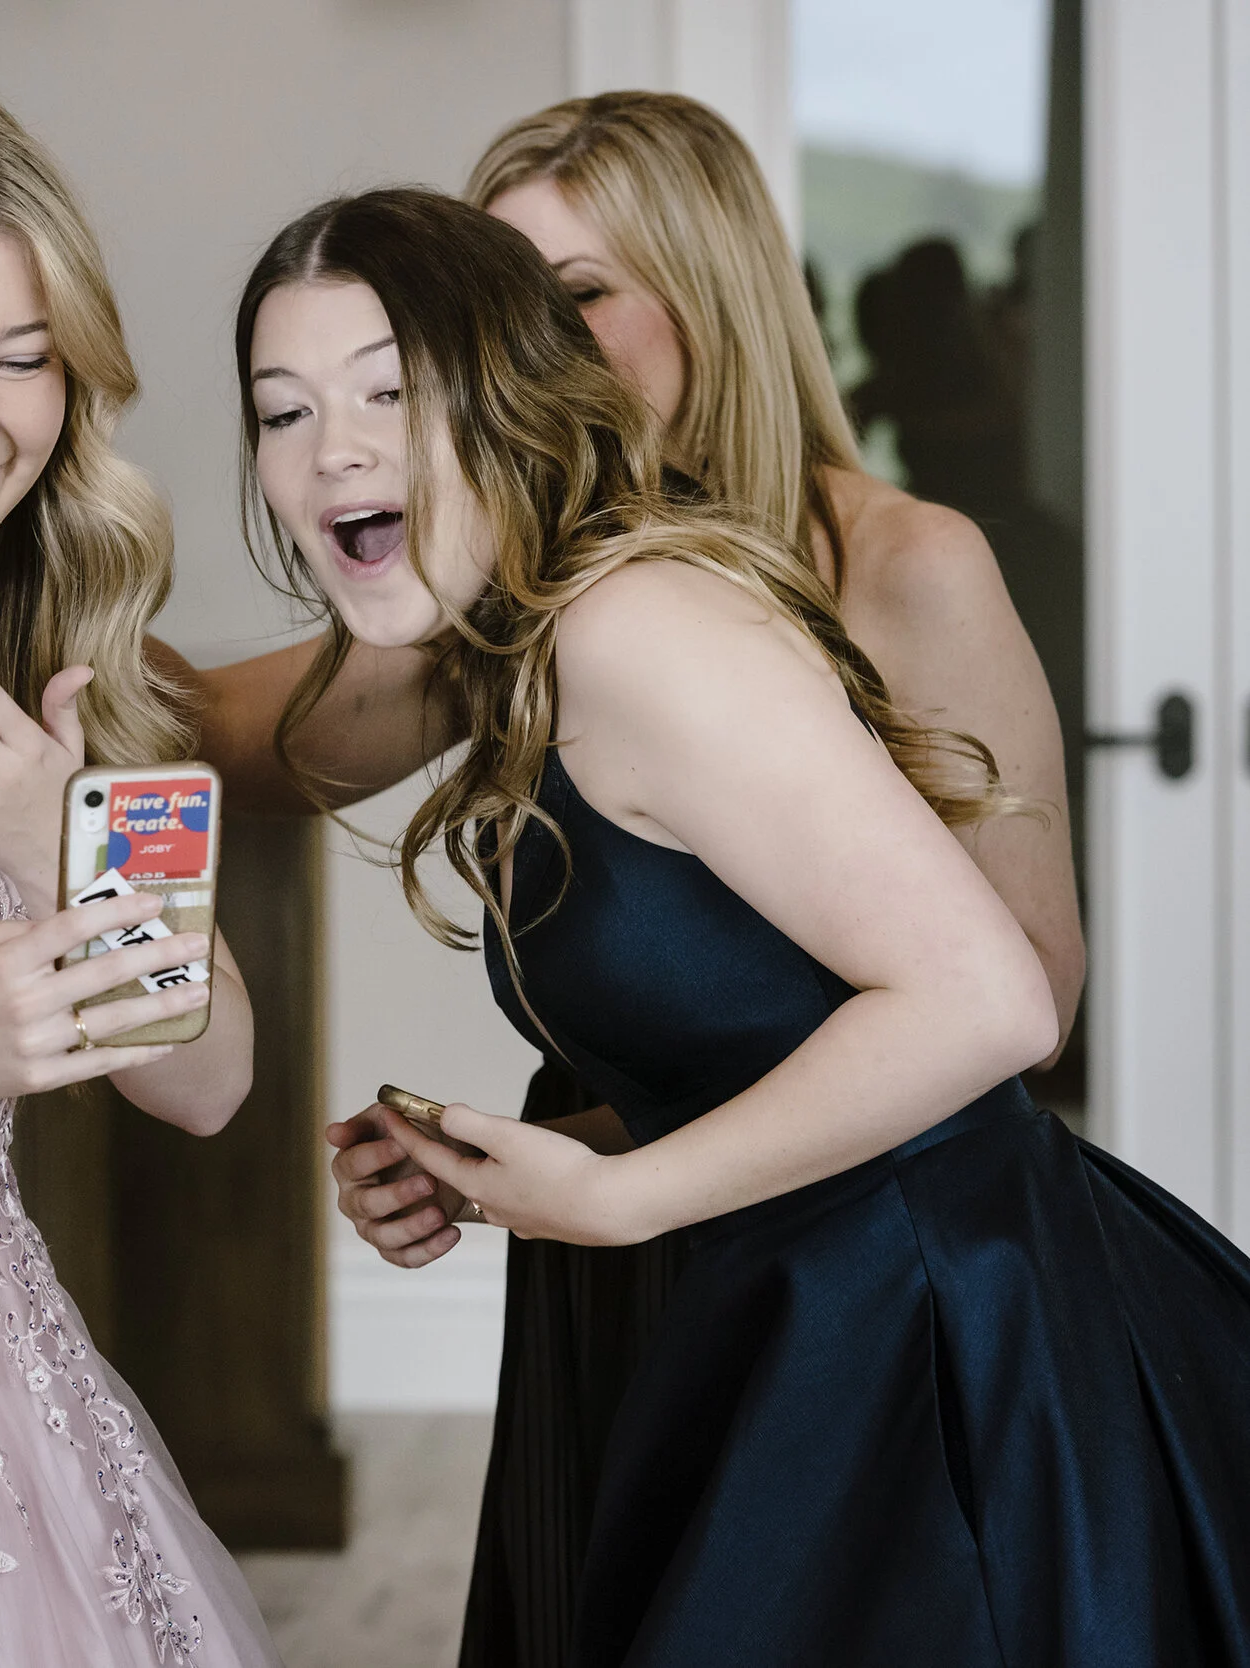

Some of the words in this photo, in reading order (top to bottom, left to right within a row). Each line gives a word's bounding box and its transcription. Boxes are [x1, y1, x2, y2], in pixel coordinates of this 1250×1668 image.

[113, 795, 165, 811] Have
[165, 791, 207, 813] fun.
[112, 815, 184, 833] Create.
[139, 844, 174, 854] JOBY
